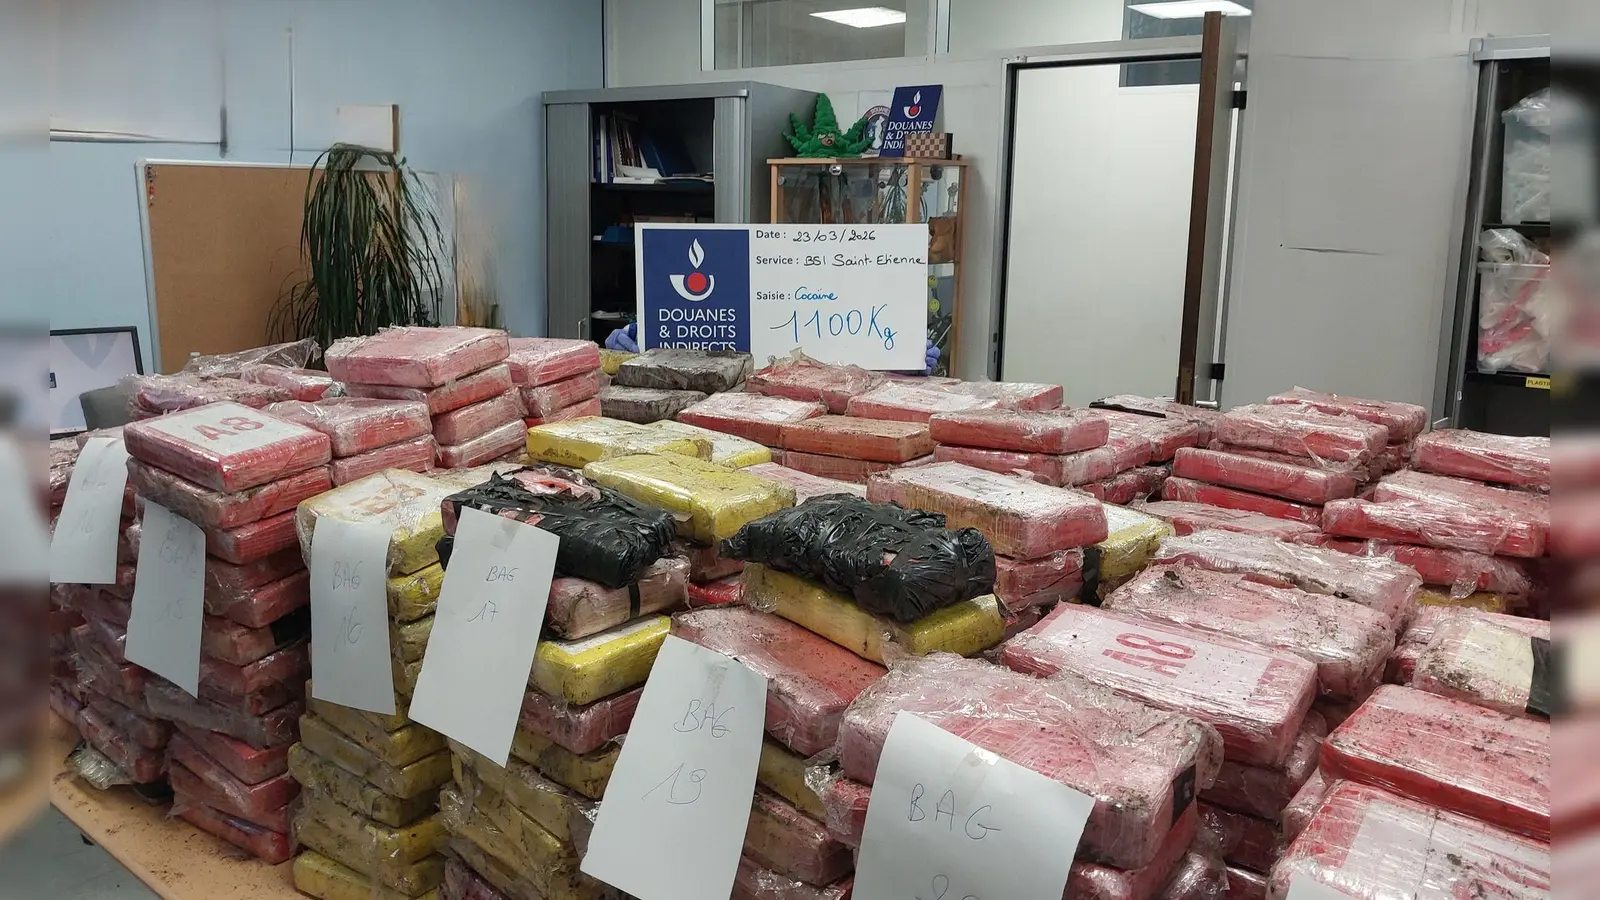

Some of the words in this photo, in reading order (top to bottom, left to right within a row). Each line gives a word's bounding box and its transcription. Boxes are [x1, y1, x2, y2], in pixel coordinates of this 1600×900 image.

[887, 121, 933, 131] DOUANES
[793, 229, 876, 243] 23/03/2026
[803, 255, 827, 266] BSI
[794, 286, 839, 300] Cocaïne
[659, 308, 736, 321] DOUANES
[659, 325, 671, 338] &
[677, 325, 736, 338] DROITS
[193, 416, 264, 440] A8
[332, 560, 364, 591] BAG
[486, 565, 519, 582] BAG
[467, 600, 499, 623] 17
[333, 606, 364, 653] 16
[1102, 632, 1196, 679] A8
[673, 698, 736, 739] BAG
[907, 782, 1002, 840] BAG
